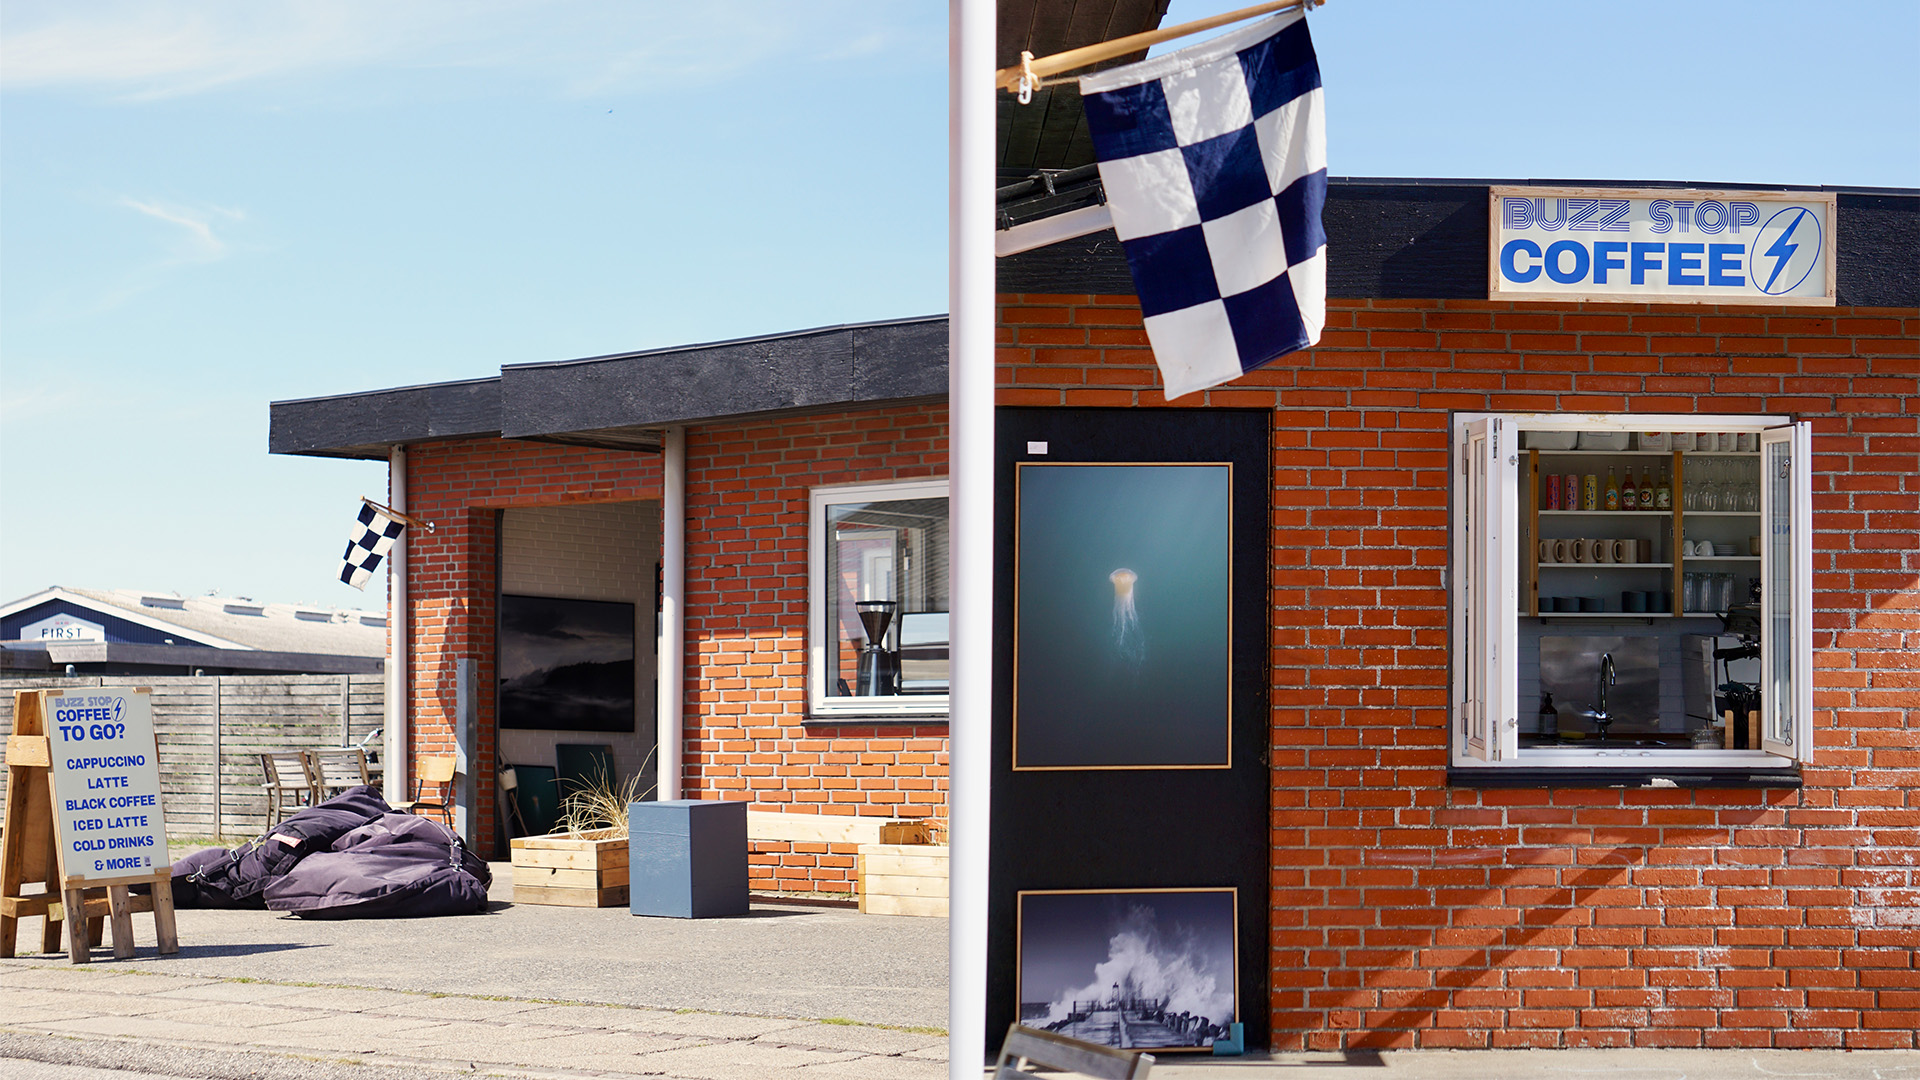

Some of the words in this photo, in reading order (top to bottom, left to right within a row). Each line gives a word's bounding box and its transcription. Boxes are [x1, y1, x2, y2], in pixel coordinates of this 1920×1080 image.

[1503, 197, 1631, 233] BUZZ
[1649, 199, 1761, 236] STOP
[1500, 239, 1746, 287] COFFEE
[41, 627, 82, 639] FIRST
[55, 697, 84, 708] BUZZ
[87, 696, 112, 707] STOP
[56, 708, 111, 722] COFFEE
[59, 725, 85, 742] TO
[89, 723, 126, 740] GO?
[66, 755, 145, 770] CAPPUCCINO
[87, 776, 129, 789] LATTE
[66, 798, 107, 811] BLACK
[109, 794, 156, 808] COFFEE
[73, 818, 104, 831] ICED
[107, 815, 148, 829] LATTE
[73, 839, 106, 852] COLD
[108, 835, 154, 849] DRINKS
[94, 859, 104, 871] &
[106, 857, 141, 870] MORE
